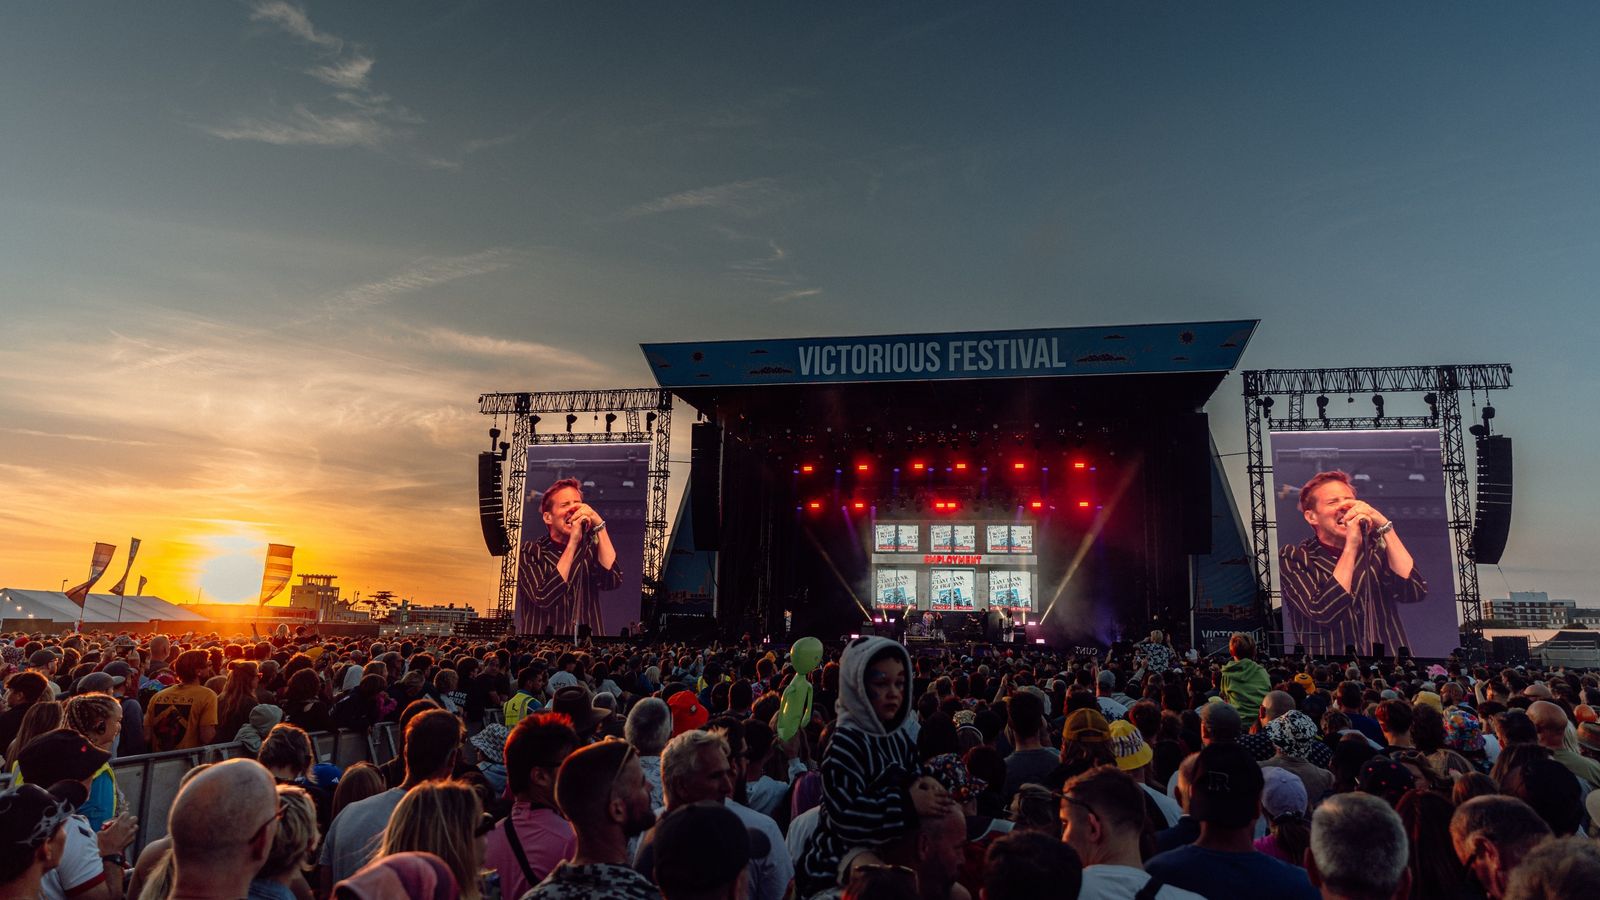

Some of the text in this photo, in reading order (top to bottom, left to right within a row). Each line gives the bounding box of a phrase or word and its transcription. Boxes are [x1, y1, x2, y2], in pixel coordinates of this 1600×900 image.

[798, 337, 1067, 376] VICTORIOUS FESTIVAL
[924, 554, 982, 566] EMPLOYMENT
